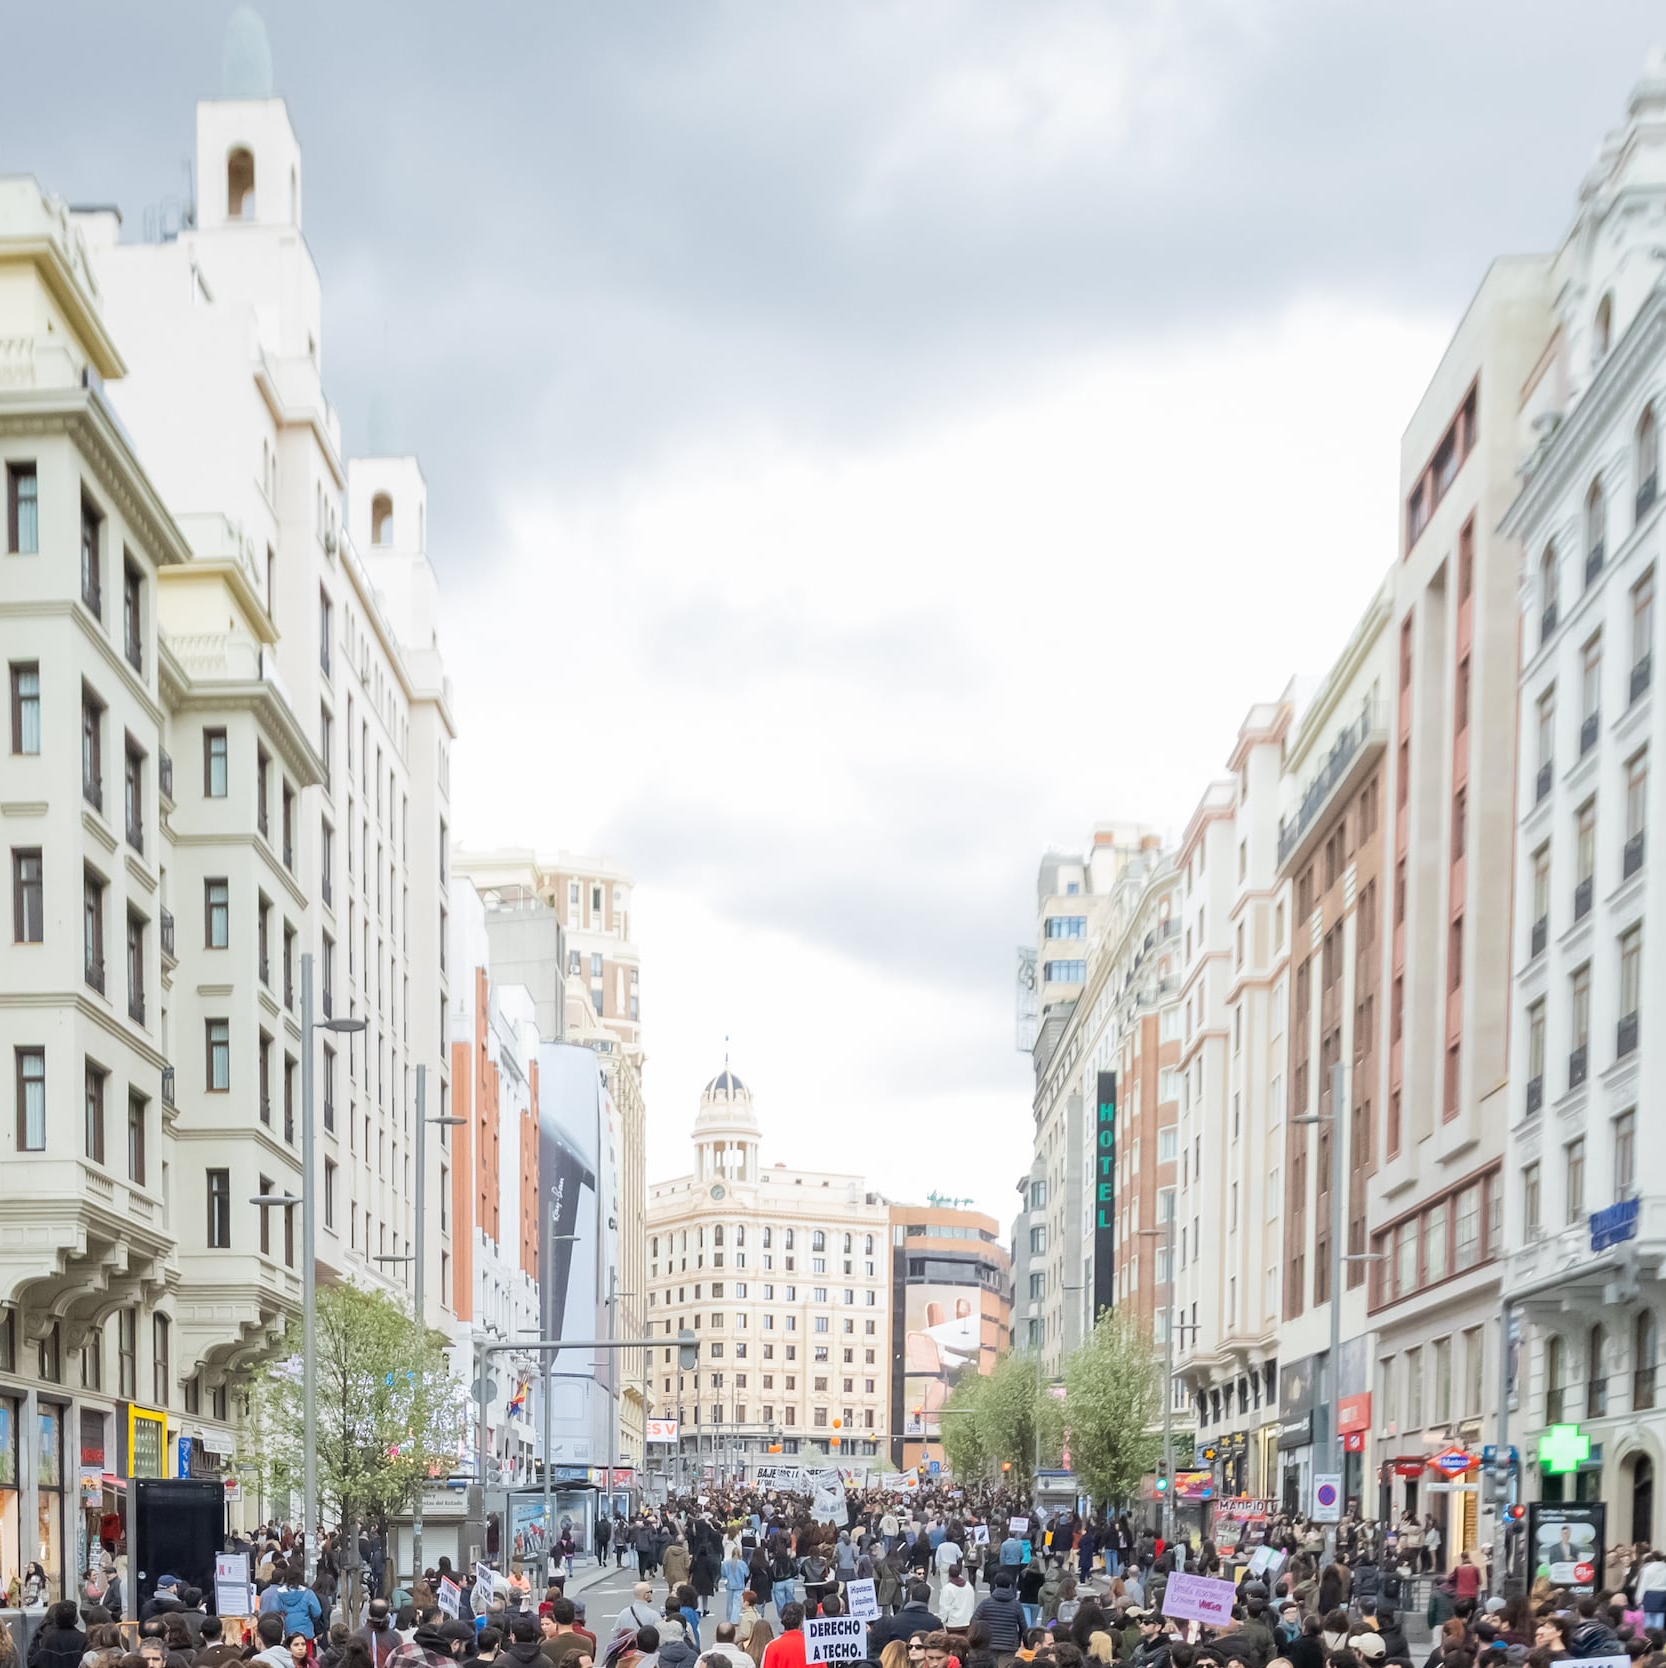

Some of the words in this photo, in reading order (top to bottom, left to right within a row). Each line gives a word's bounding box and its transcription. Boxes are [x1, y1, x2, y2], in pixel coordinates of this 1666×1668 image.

[1098, 1103, 1114, 1228] HOTEL
[1441, 1456, 1468, 1467] Metro
[1219, 1501, 1264, 1511] MADRID
[810, 1620, 860, 1638] DERECHO
[813, 1645, 821, 1660] A
[823, 1643, 861, 1659] TECHO.
